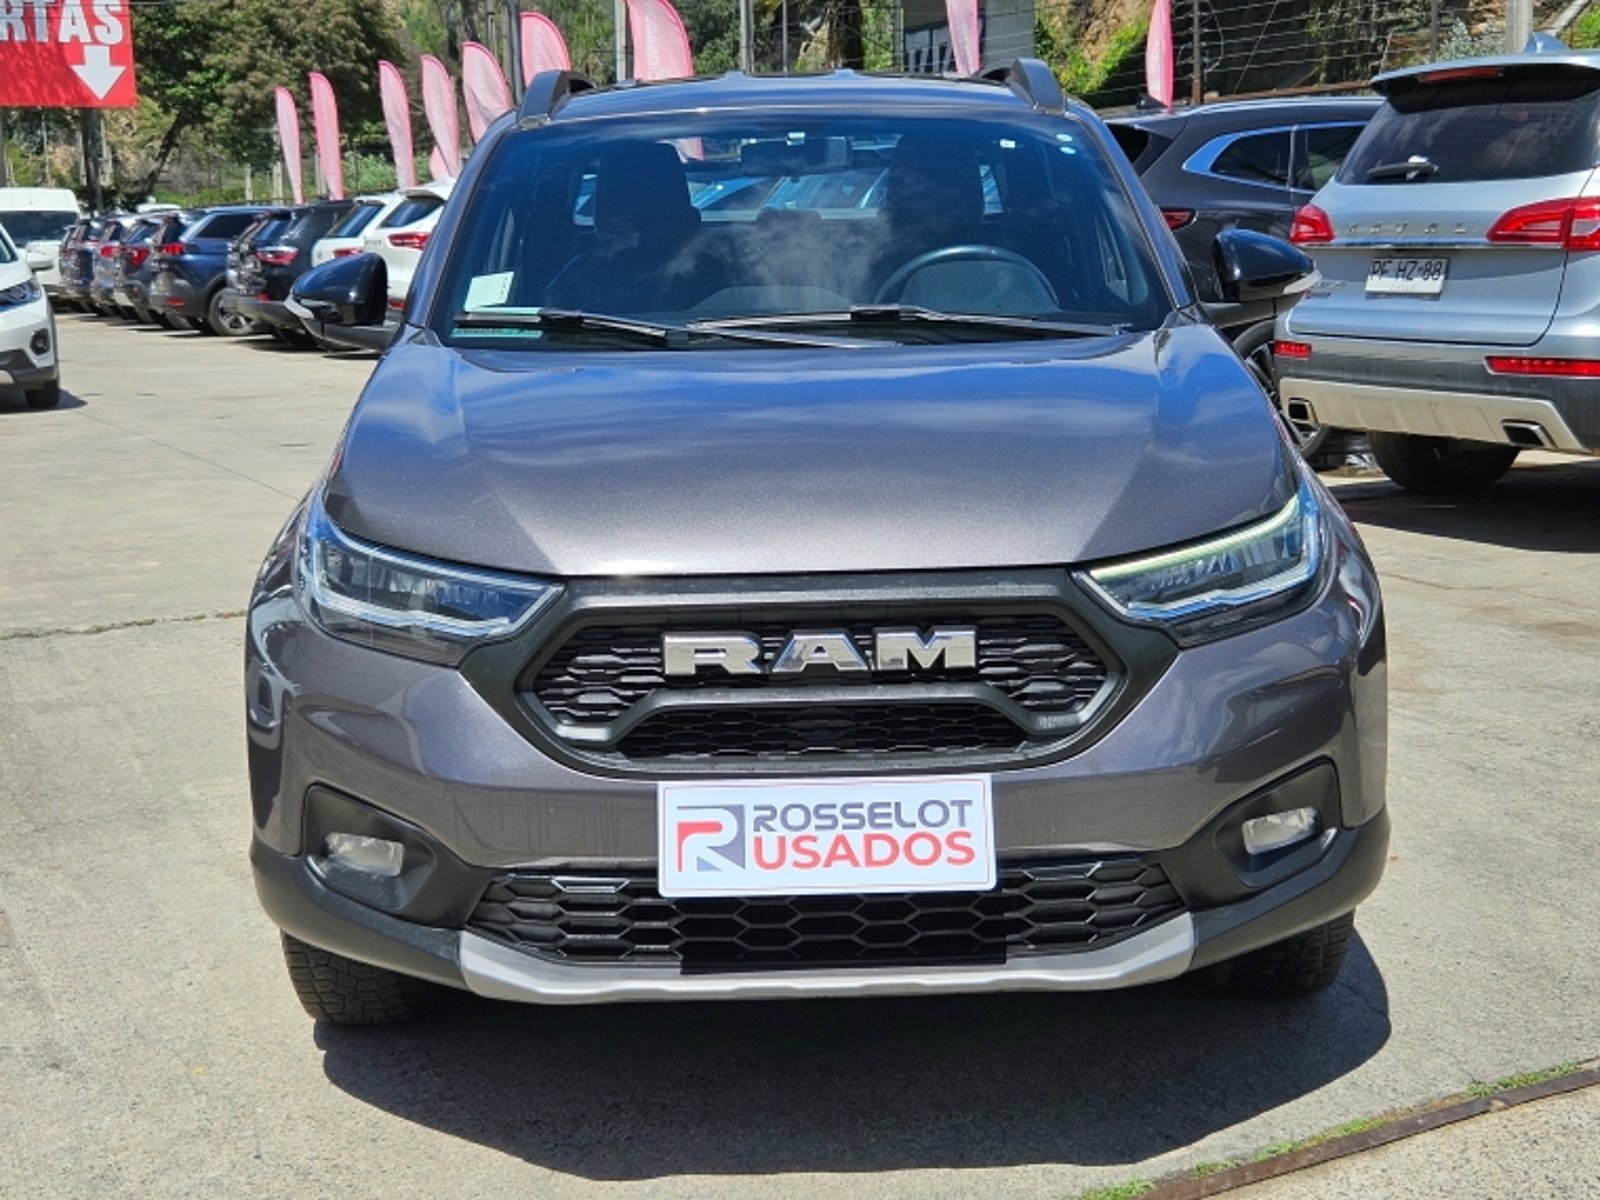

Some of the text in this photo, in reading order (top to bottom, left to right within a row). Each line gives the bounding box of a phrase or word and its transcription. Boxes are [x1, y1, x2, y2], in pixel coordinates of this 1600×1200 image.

[0, 0, 123, 45] RTAS
[663, 629, 976, 675] RAM
[752, 799, 974, 833] ROSSELOT
[753, 831, 976, 870] USADOS
